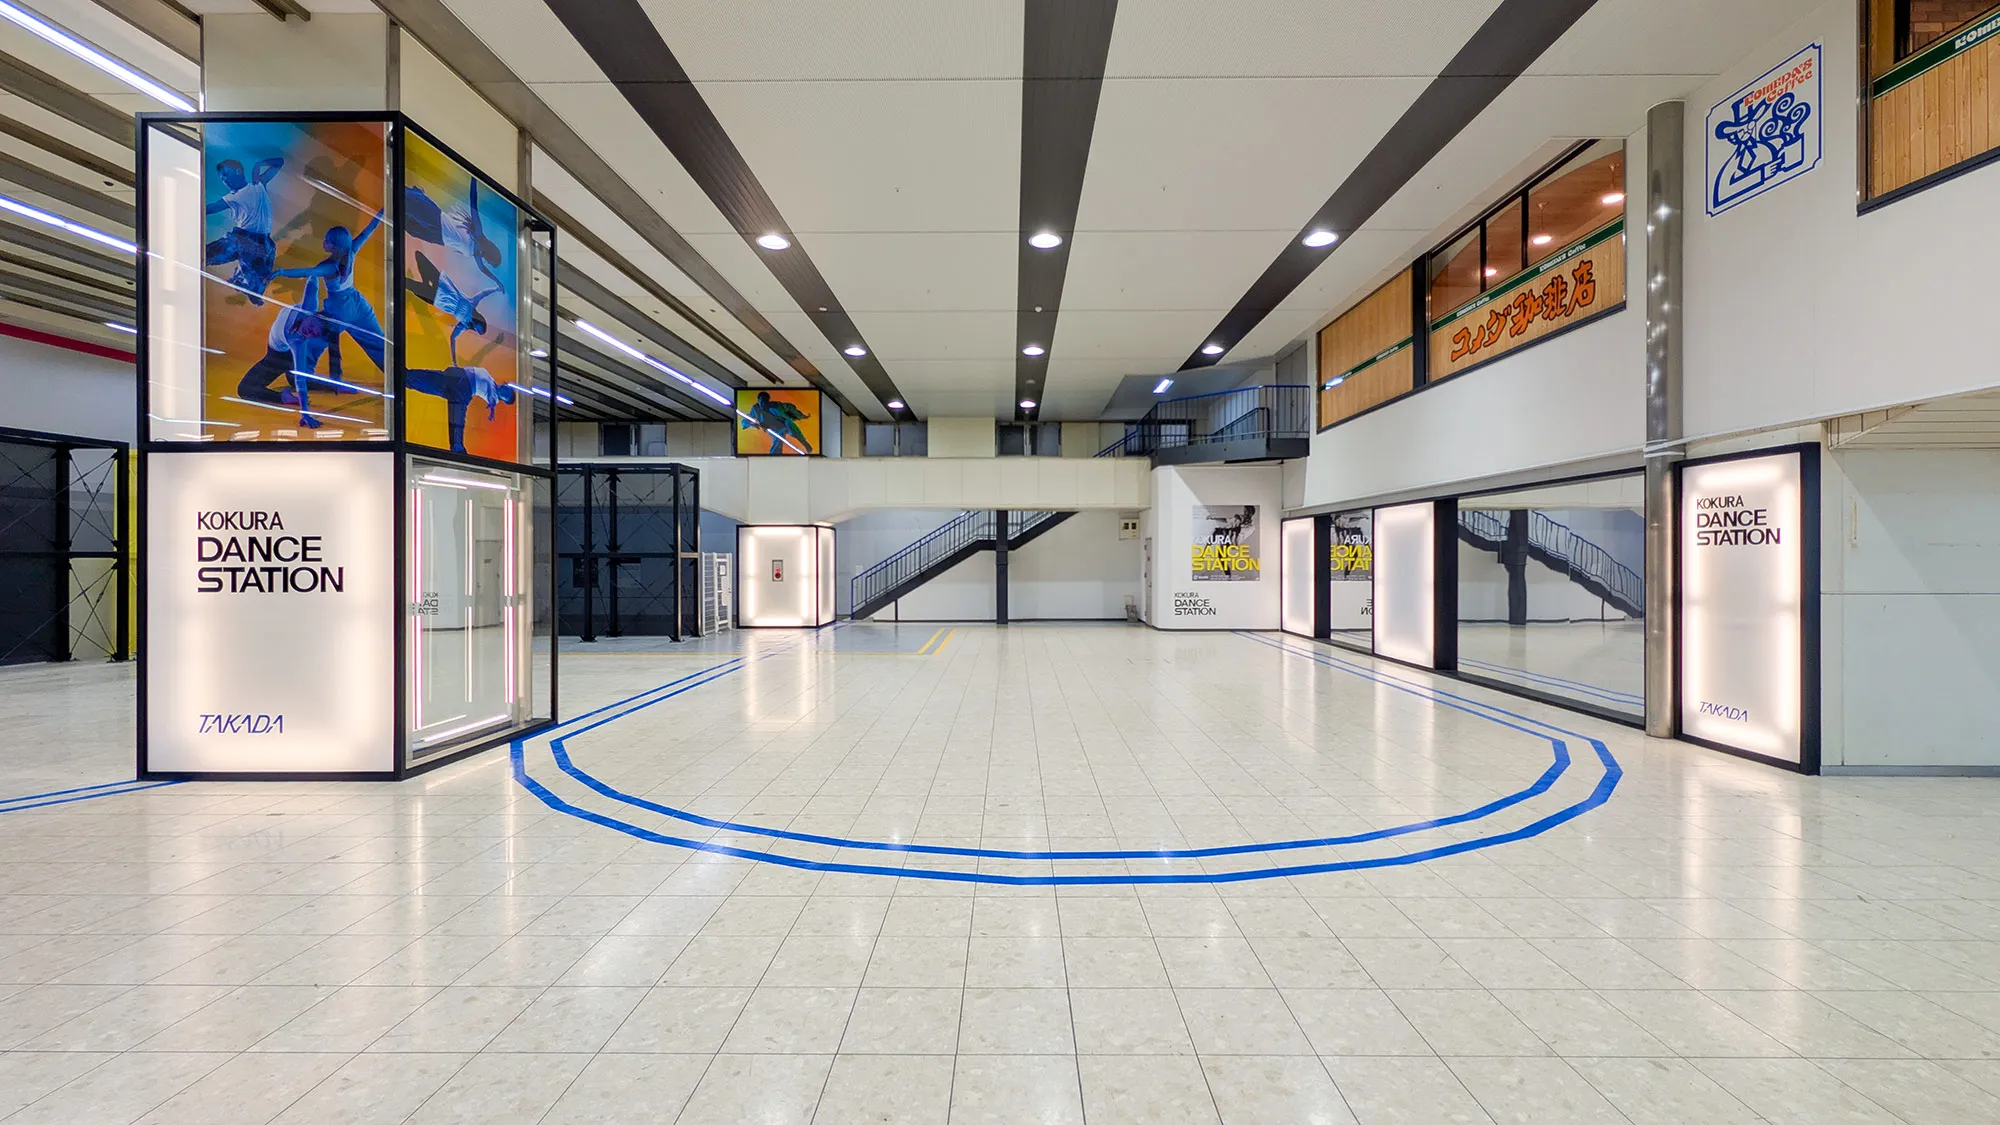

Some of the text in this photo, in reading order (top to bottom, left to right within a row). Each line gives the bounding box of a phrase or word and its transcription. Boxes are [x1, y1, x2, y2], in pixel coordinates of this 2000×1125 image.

[1744, 57, 1813, 106] KOMEDA'S
[1766, 70, 1813, 103] Coffee
[1451, 260, 1595, 362] コメダ珈琲店
[1696, 495, 1744, 509] KOKURA
[197, 512, 284, 530] KOKURA
[1697, 509, 1767, 528] DANCE
[1696, 528, 1781, 546] STATION
[197, 536, 322, 562] DANCE
[1192, 544, 1250, 558] DANCE
[1192, 558, 1260, 571] STATION
[197, 566, 344, 593] STATION
[1174, 599, 1210, 607] DANCE
[1174, 607, 1217, 616] STATION
[1699, 701, 1748, 723] TAKADA
[199, 714, 283, 733] TAKADA
